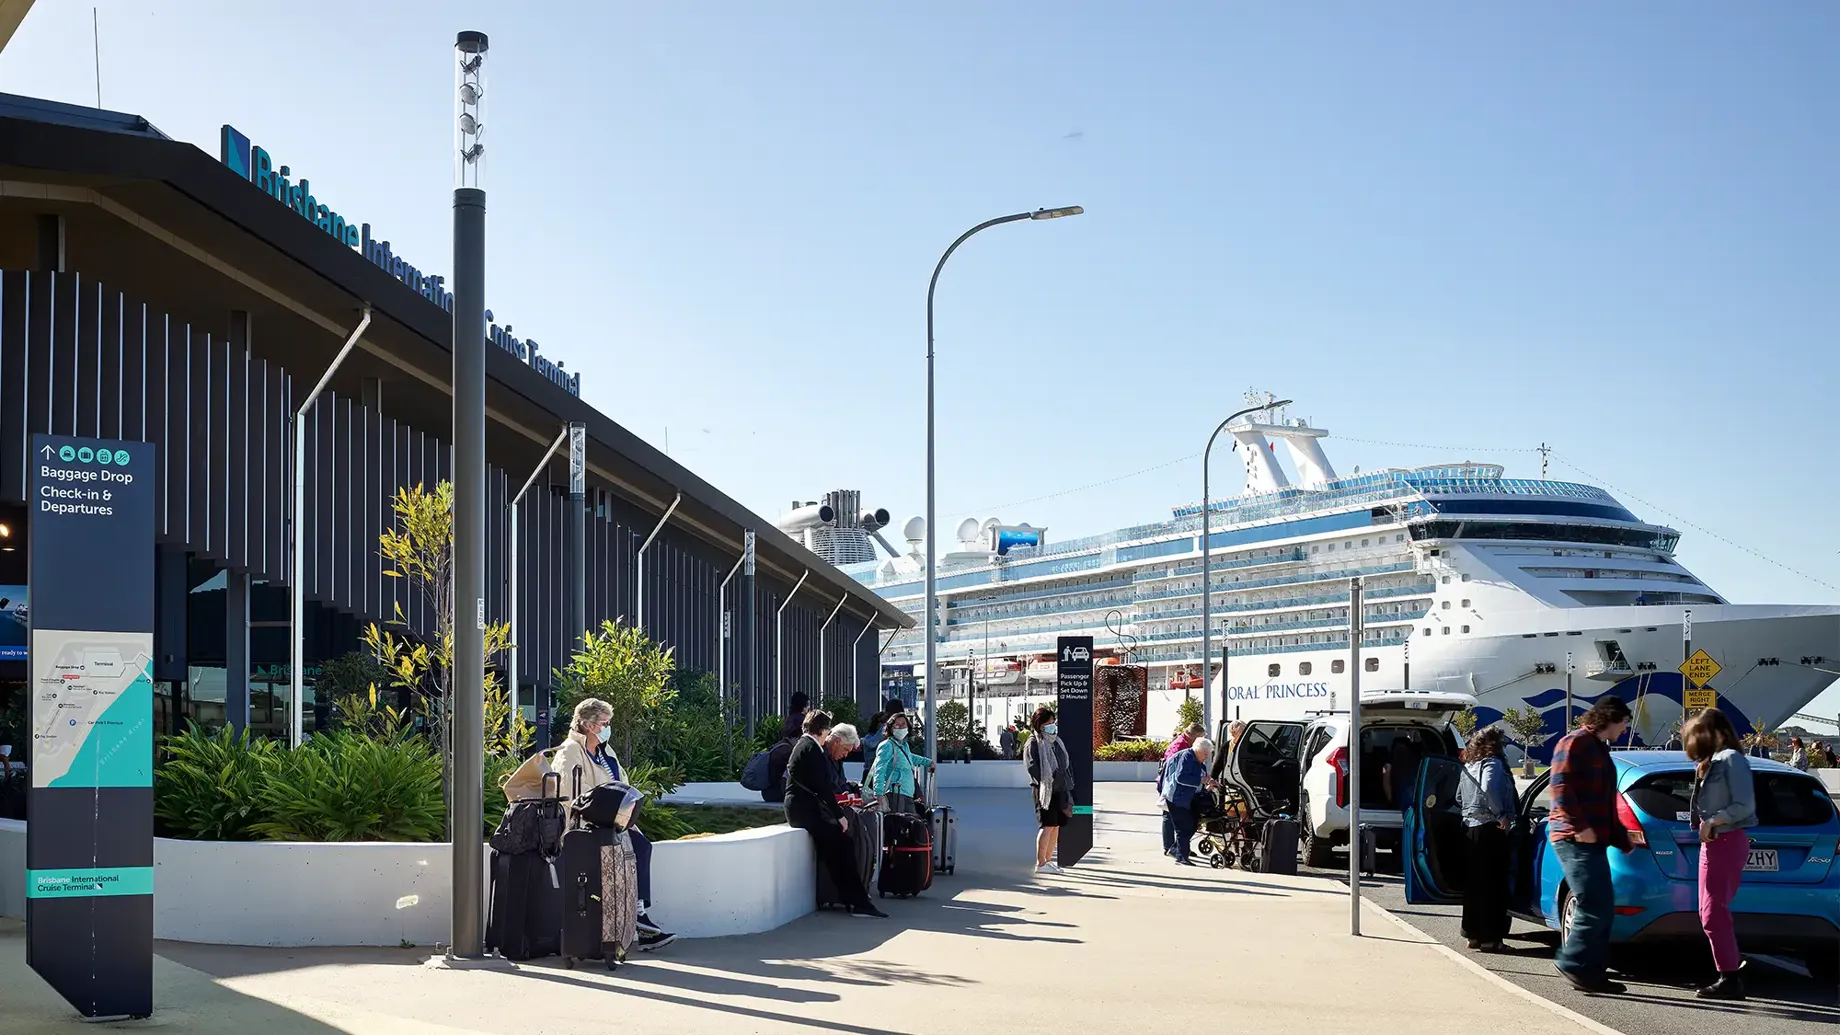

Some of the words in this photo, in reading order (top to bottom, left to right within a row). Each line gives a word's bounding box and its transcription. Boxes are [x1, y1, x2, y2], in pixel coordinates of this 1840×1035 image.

[251, 145, 360, 248] Brisbane
[361, 223, 453, 316] Internatio
[526, 338, 581, 400] Terminal
[41, 465, 98, 482] Baggage
[101, 469, 133, 485] Drop
[40, 485, 99, 500] Check-in
[102, 489, 112, 501] &
[41, 500, 113, 516] Departures
[270, 664, 323, 676] Brisane
[1221, 685, 1260, 701] ORAL
[1266, 682, 1328, 699] PRINCESS
[71, 874, 120, 883] International
[37, 883, 62, 892] Cruise
[63, 883, 96, 891] Terminal
